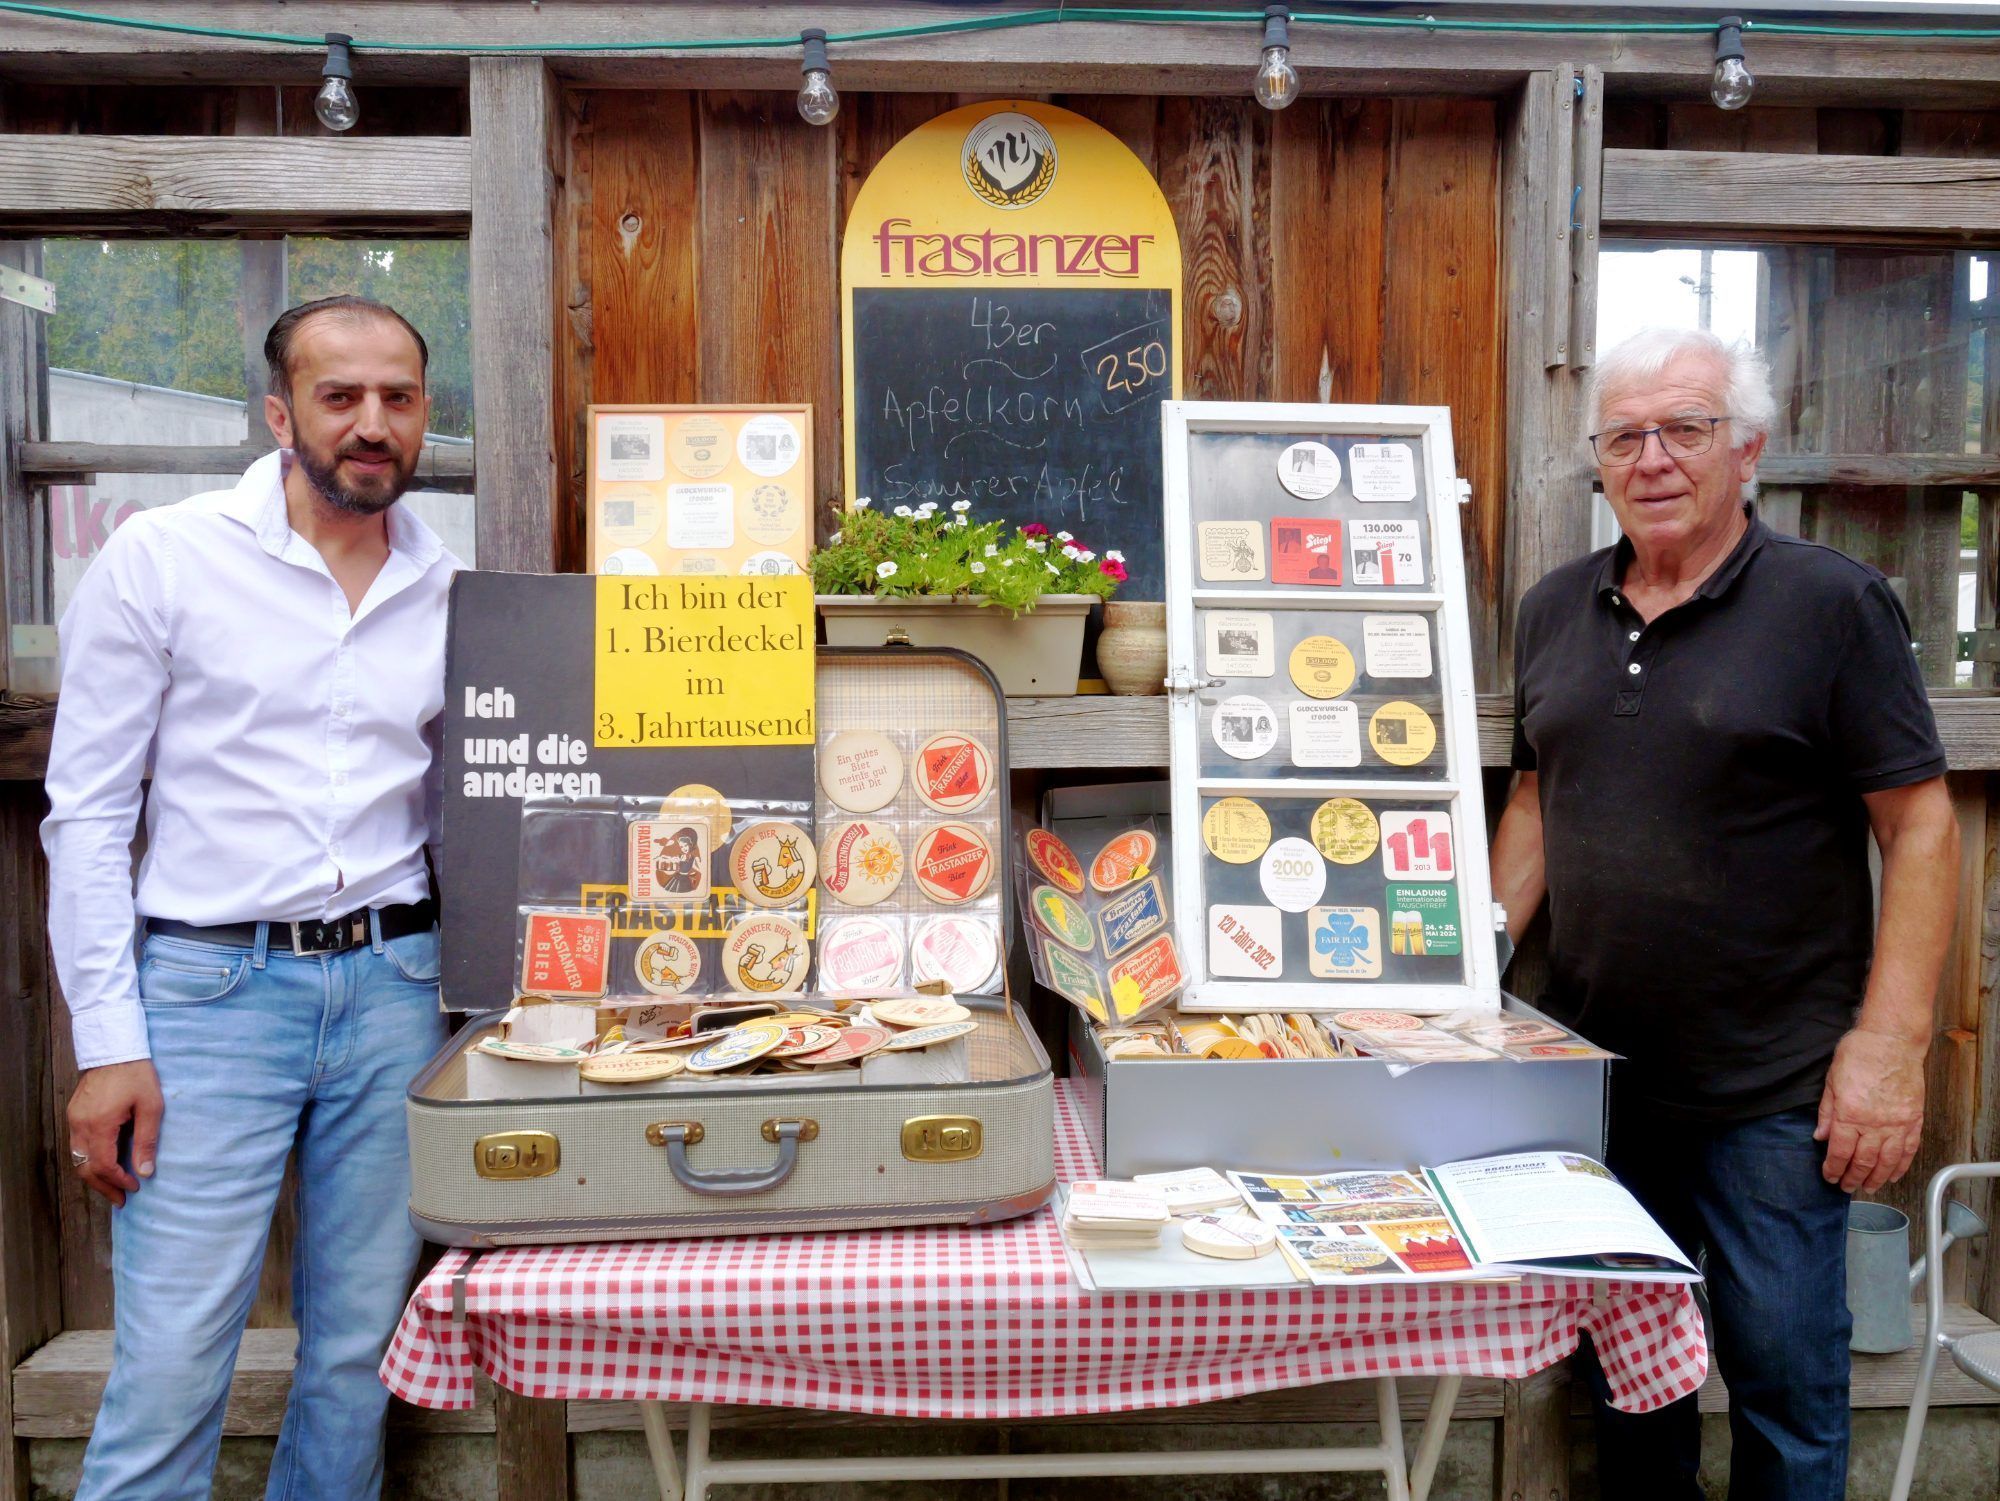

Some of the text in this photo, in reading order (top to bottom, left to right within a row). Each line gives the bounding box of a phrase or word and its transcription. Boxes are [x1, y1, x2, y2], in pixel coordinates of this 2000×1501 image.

[873, 218, 1155, 277] frastanzer
[971, 297, 1057, 350] 43er
[1363, 524, 1403, 533] 130.000
[1398, 553, 1412, 562] 70
[621, 582, 788, 611] Ich bin der
[607, 624, 804, 654] 1. Bierdeckel
[686, 668, 725, 695] im
[464, 686, 515, 719] Ich
[597, 709, 813, 744] 3. Jahrtausend
[464, 733, 588, 765] und die
[463, 766, 601, 797] anderen
[850, 760, 872, 773] Bier
[737, 829, 778, 882] FRASTANZER BIER
[937, 841, 958, 855] Trink
[1272, 859, 1314, 877] 2000
[1414, 863, 1432, 871] 2013
[1396, 889, 1448, 897] EINLADUNG
[732, 922, 792, 953] FRASTANZER BIER
[1217, 914, 1276, 971] 120 Jahre 2022
[1320, 936, 1341, 944] FAIR
[534, 941, 551, 981] BIER
[545, 919, 583, 990] FRASTANZER
